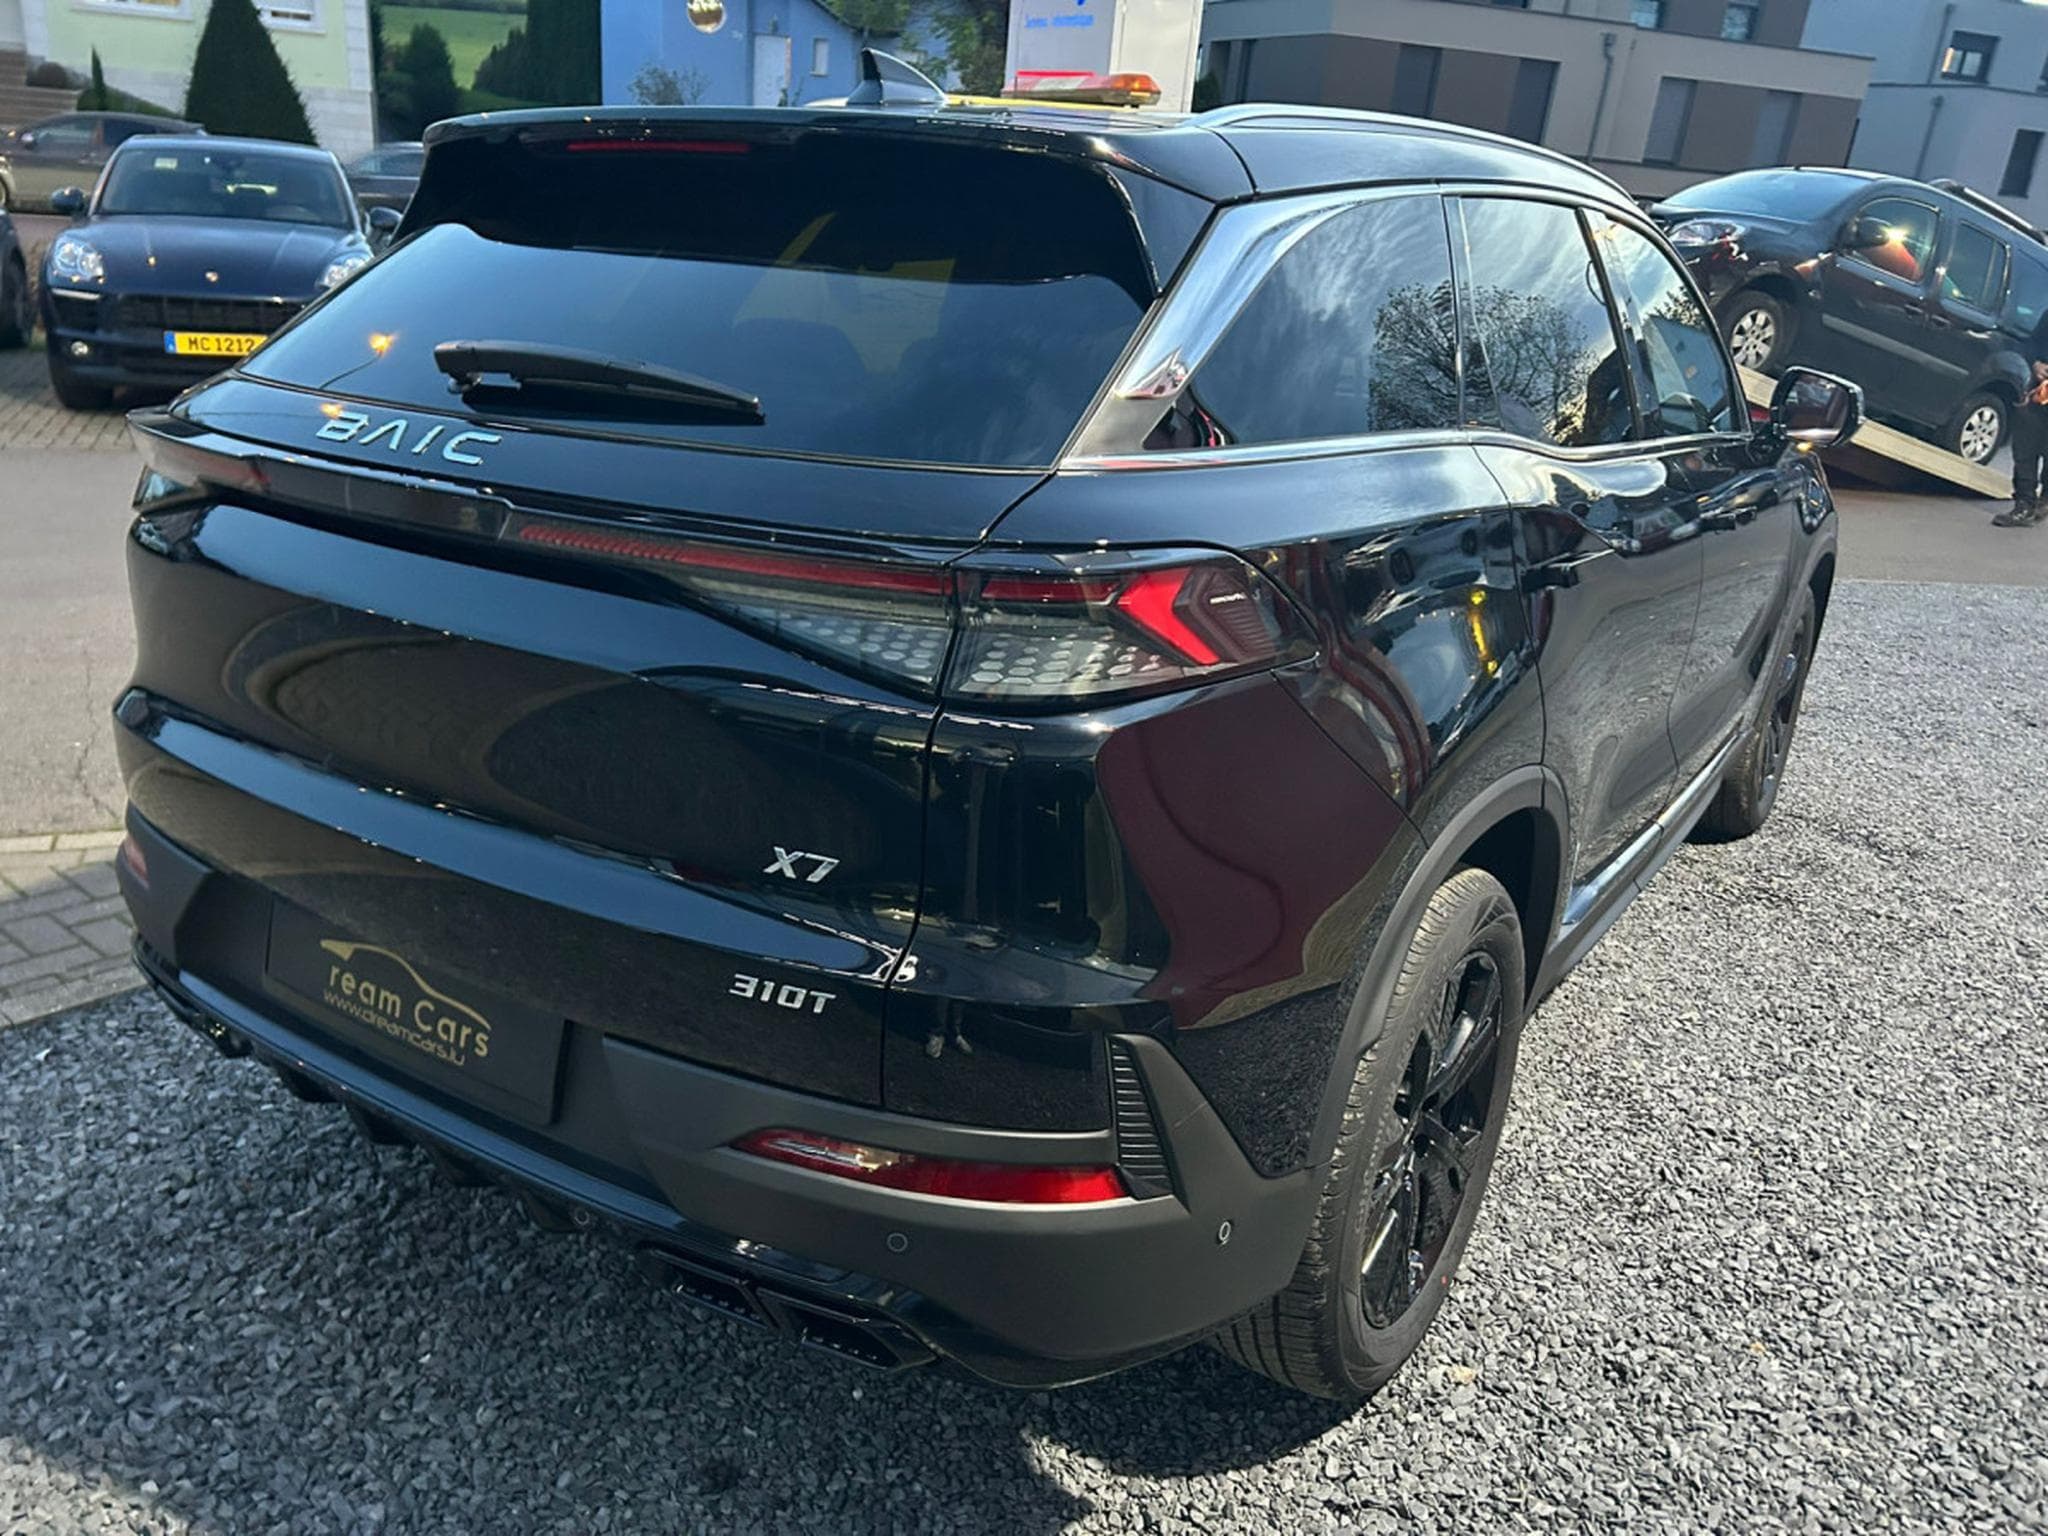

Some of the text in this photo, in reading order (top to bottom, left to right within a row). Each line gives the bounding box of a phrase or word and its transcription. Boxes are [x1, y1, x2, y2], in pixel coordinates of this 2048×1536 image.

[215, 338, 256, 353] 1212
[315, 410, 502, 466] BAIC
[763, 846, 840, 884] X7
[328, 964, 491, 1058] ream Cars
[729, 973, 837, 1014] 310T
